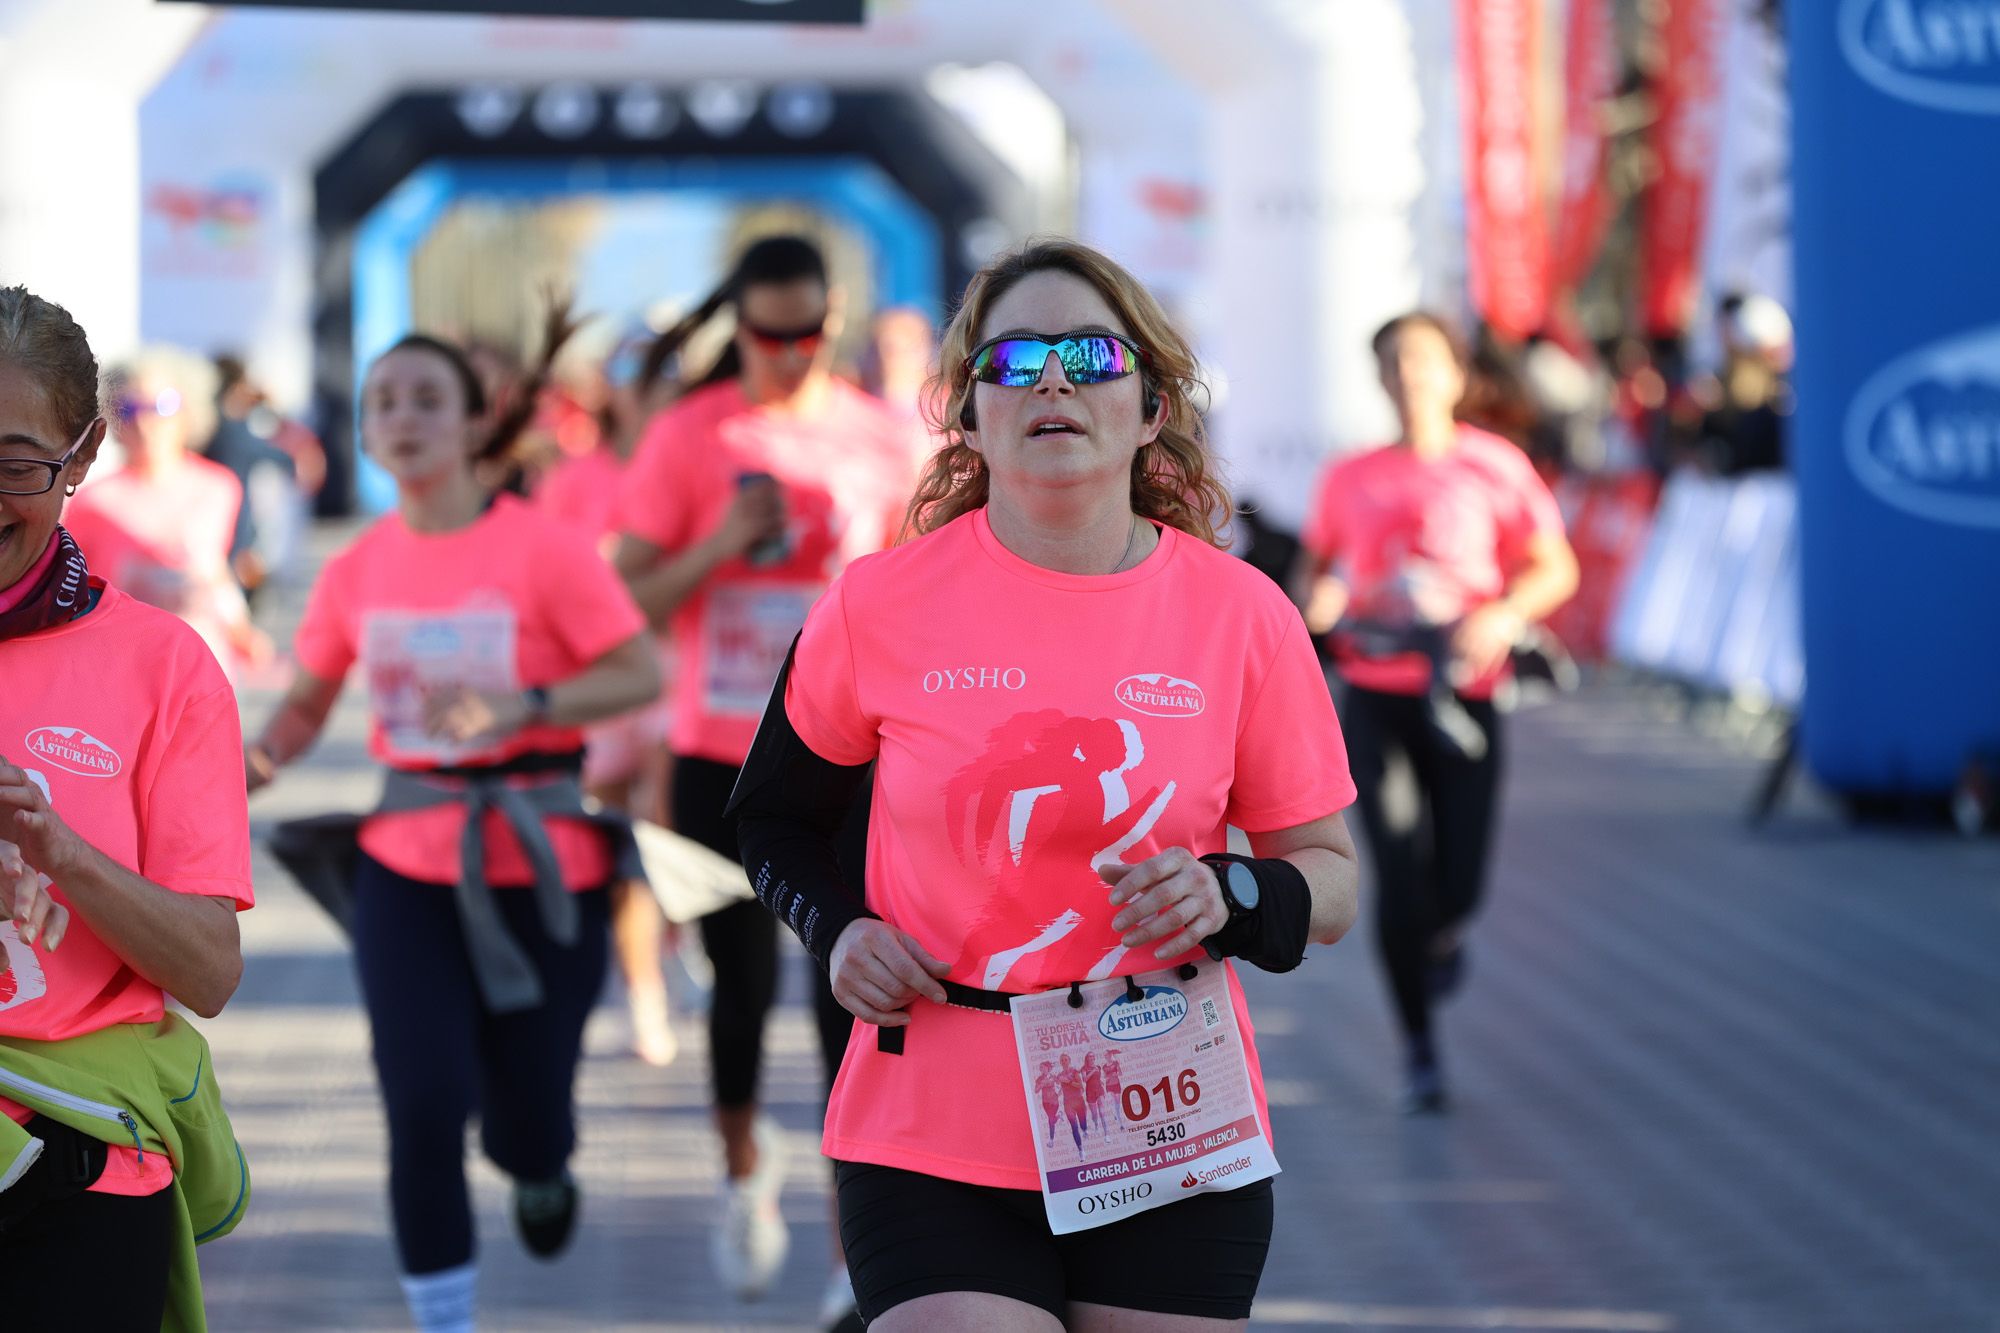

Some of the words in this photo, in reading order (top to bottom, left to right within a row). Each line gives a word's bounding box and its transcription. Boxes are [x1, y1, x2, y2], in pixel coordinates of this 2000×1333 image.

[922, 667, 1027, 694] OYSHO
[1137, 684, 1166, 694] CENTRAL
[1121, 683, 1200, 711] ASTURIANA
[31, 735, 115, 772] ASTURIANA
[50, 736, 81, 750] CENTRAL
[1106, 1002, 1184, 1035] ASTURIANA
[1117, 1003, 1147, 1016] CENTRAL
[1035, 1026, 1048, 1037] TU
[1050, 1021, 1087, 1035] DORSAL
[1040, 1031, 1091, 1052] SUMA
[1121, 1068, 1201, 1122] 016
[1146, 1122, 1186, 1147] 5430
[1077, 1161, 1130, 1183] CARRERA
[1132, 1156, 1147, 1171] DE
[1149, 1152, 1163, 1167] LA
[1165, 1143, 1198, 1163] MUJER
[1202, 1127, 1239, 1150] VALENCIA
[1198, 1155, 1252, 1185] Santander
[1077, 1182, 1153, 1215] OYSHO
